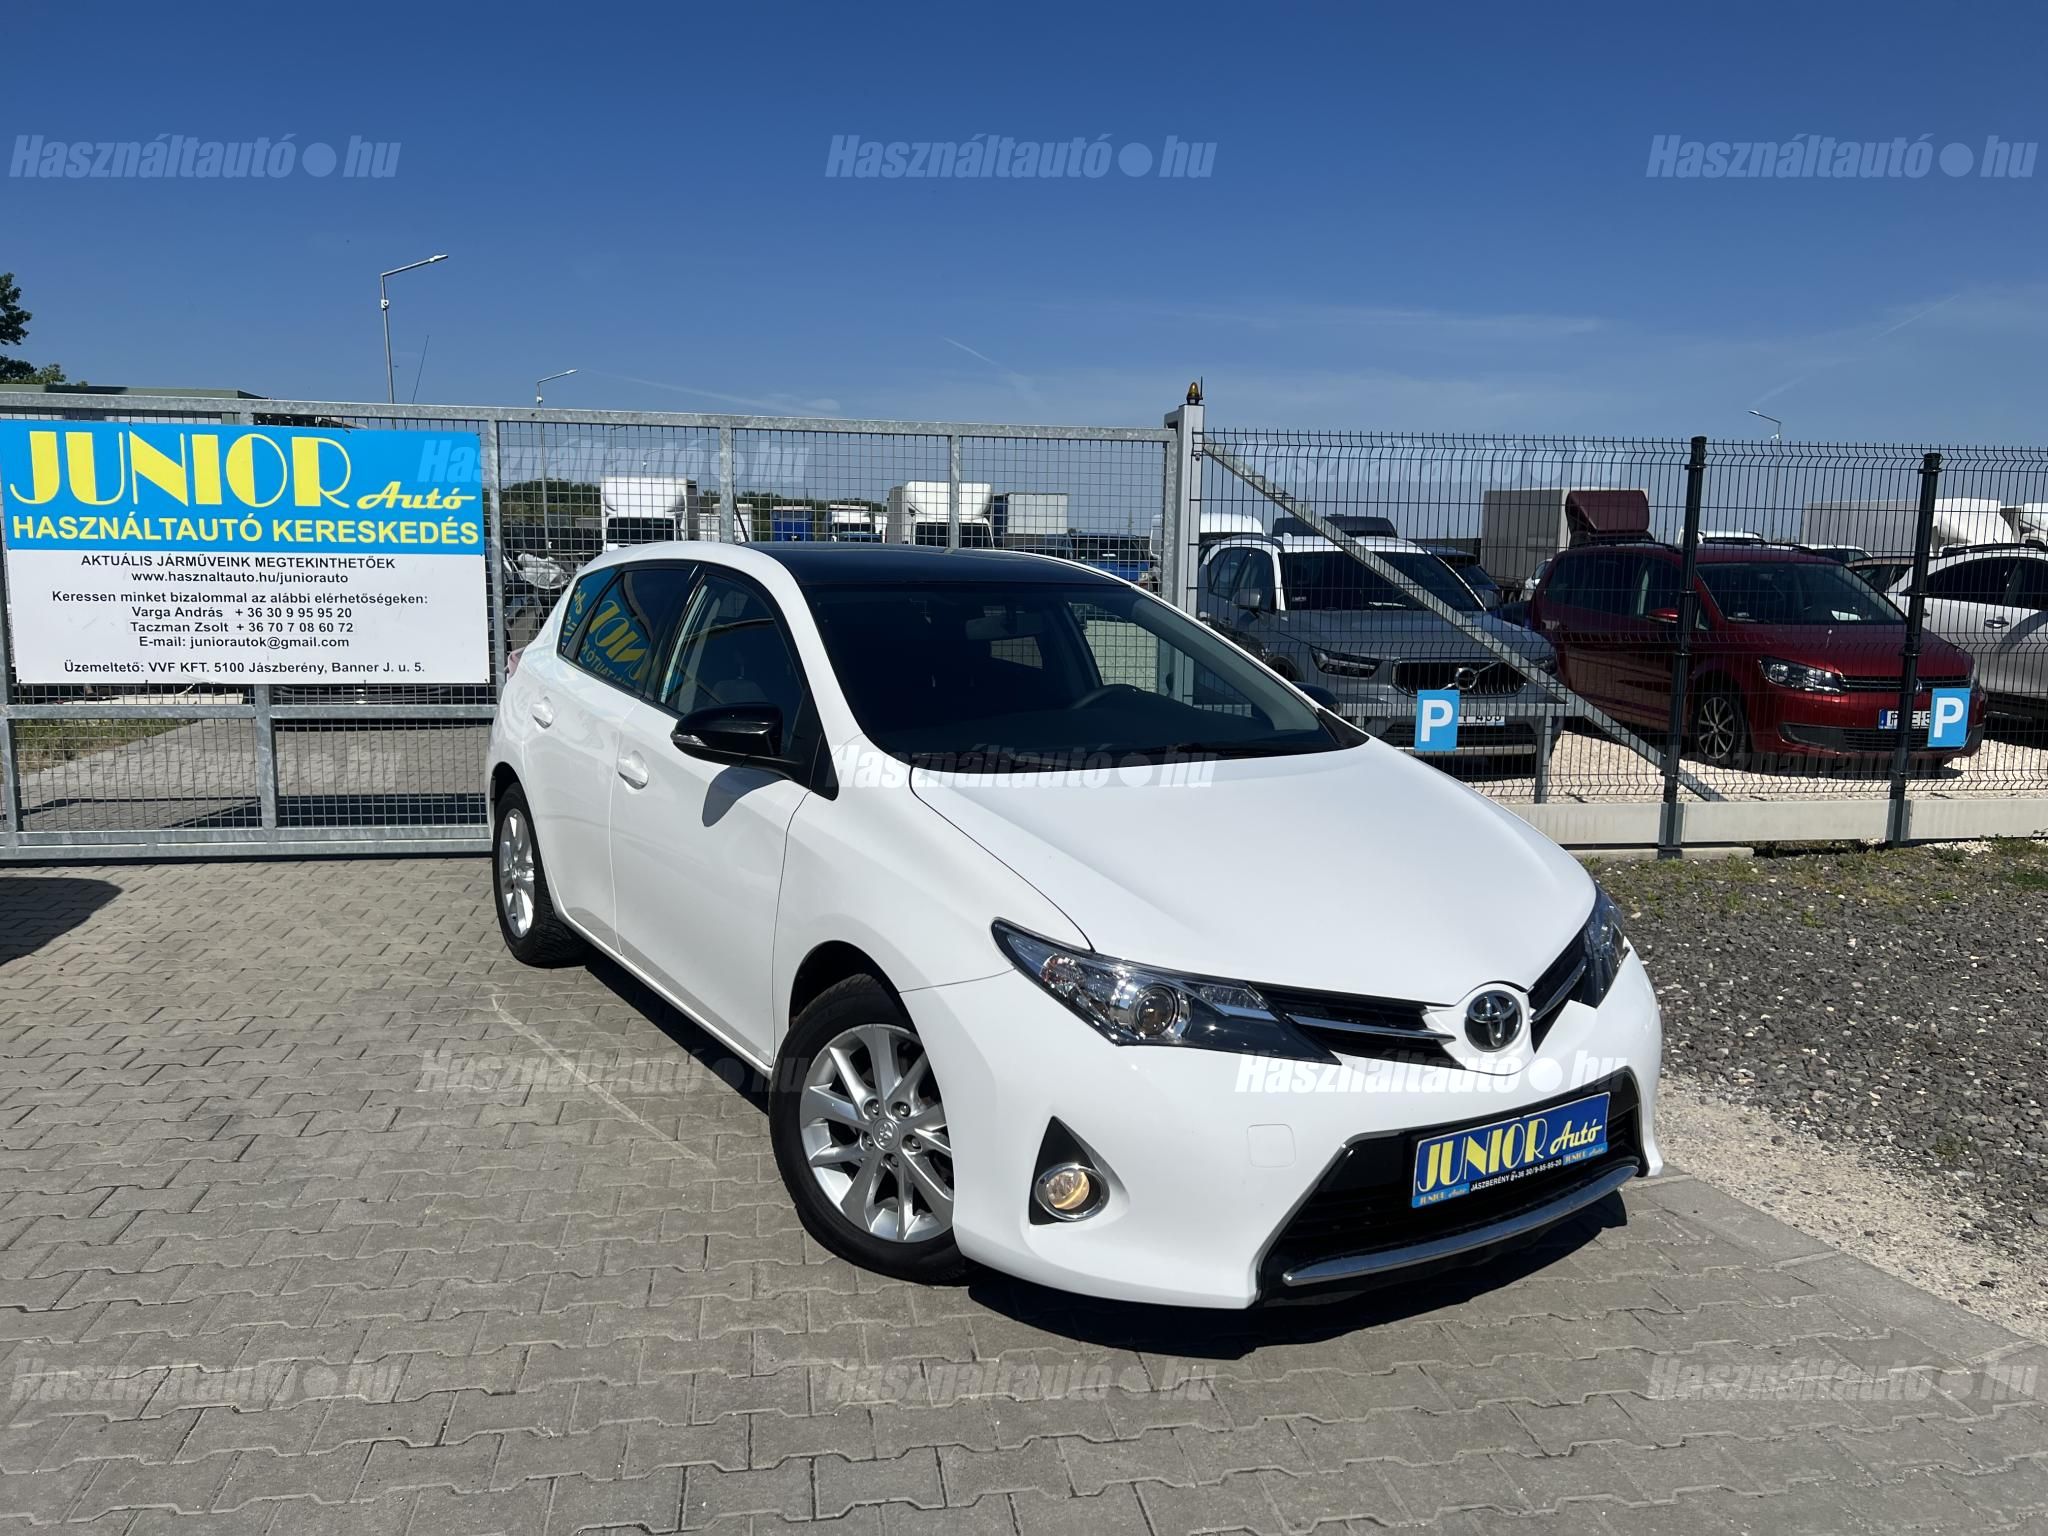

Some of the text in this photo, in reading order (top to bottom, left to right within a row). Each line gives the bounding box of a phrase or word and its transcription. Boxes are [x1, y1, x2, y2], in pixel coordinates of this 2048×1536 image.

[10, 431, 476, 510] JUNIOR Autó
[13, 513, 479, 545] HASZNÁLTAUTÓ KERESKEDÉS
[81, 553, 396, 569] AKTUÁLIS JÁRMŰVEINK MEGTEKINTHETŐEK
[131, 571, 349, 585] www.hasznaltauto.hu/juniorauto
[52, 590, 428, 607] Keressen minket bizalommal az alábbi elérhetőségeken:
[132, 606, 171, 619] Varga
[175, 606, 223, 617] András
[247, 607, 263, 618] 36
[266, 607, 282, 618] 30
[286, 607, 294, 618] 9
[297, 607, 314, 618] 95
[317, 607, 333, 618] 95
[336, 607, 352, 618] 20
[130, 621, 190, 632] Taczman
[194, 622, 228, 632] Zsolt
[248, 622, 264, 632] 36
[267, 622, 283, 632] 70
[287, 622, 295, 632] 7
[299, 622, 315, 633] 08
[318, 622, 334, 633] 60
[337, 622, 353, 633] 72
[139, 636, 350, 649] E-mail: juniorautok@gmail.com
[64, 659, 425, 675] Üzemeltető: VVF KFT. 5100 Jászberény, Banner J. u. 5.
[1421, 699, 1453, 742] P
[1933, 697, 1964, 738] P
[1417, 1118, 1603, 1192] JUNIOR Autó
